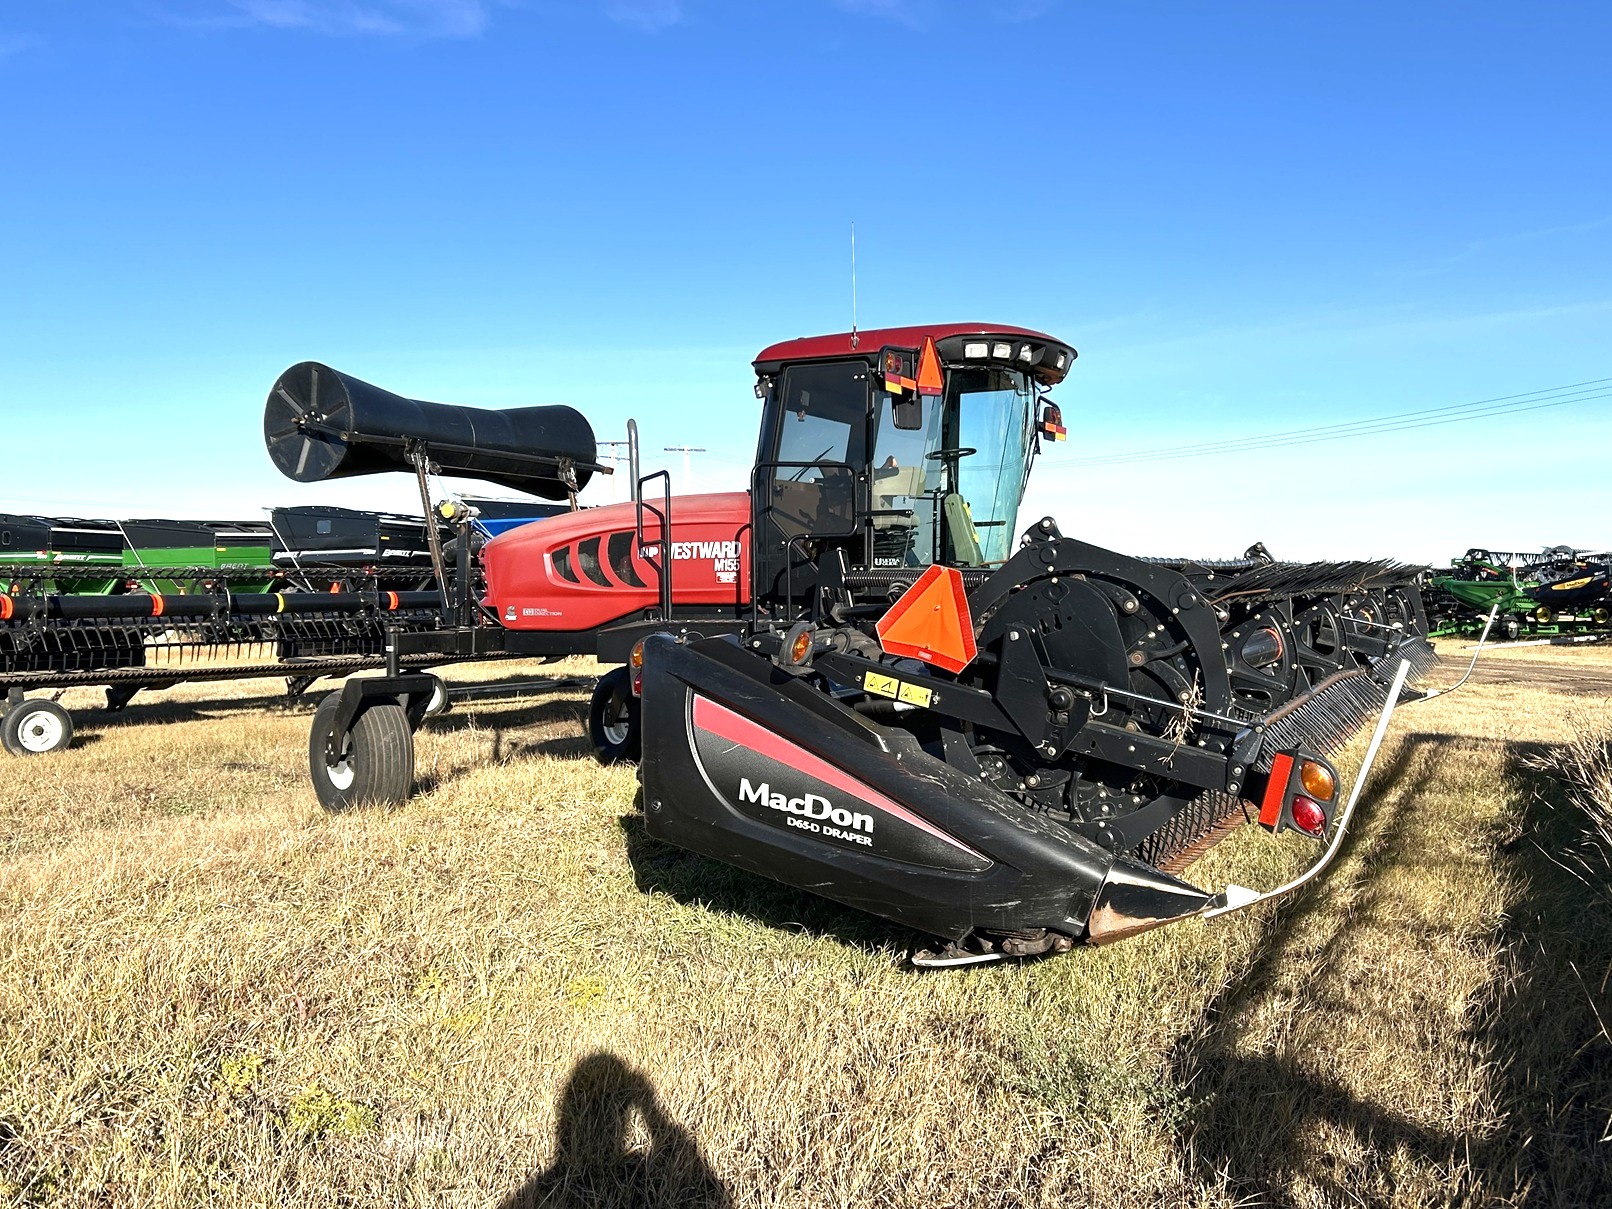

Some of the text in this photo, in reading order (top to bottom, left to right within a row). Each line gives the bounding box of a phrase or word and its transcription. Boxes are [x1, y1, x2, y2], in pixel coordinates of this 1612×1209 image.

[714, 558, 740, 572] M155
[739, 777, 874, 833] MacDon
[786, 816, 873, 847] D65-D DRAPER
